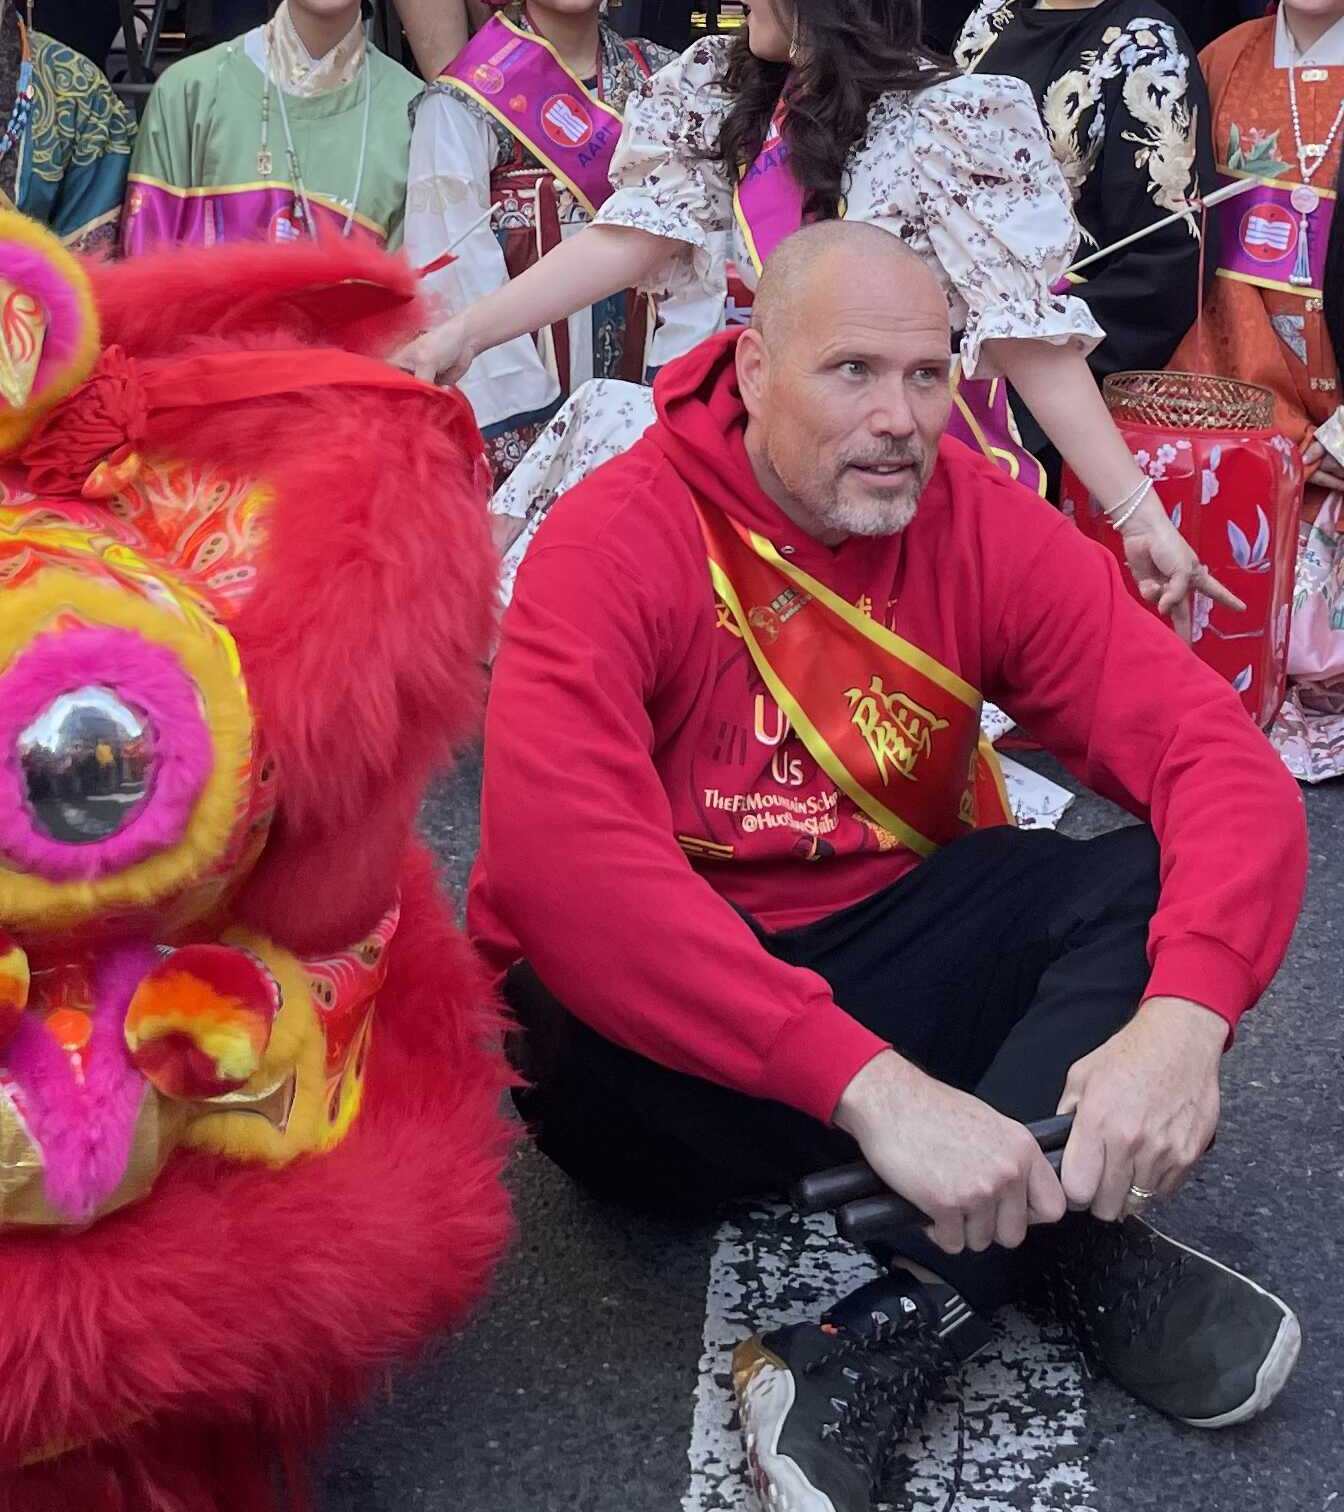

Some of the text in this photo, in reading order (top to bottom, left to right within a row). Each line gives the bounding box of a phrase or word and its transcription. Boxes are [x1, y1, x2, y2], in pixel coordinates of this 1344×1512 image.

[576, 125, 616, 170] AAPI
[749, 144, 790, 181] AAP
[771, 750, 804, 786] Us
